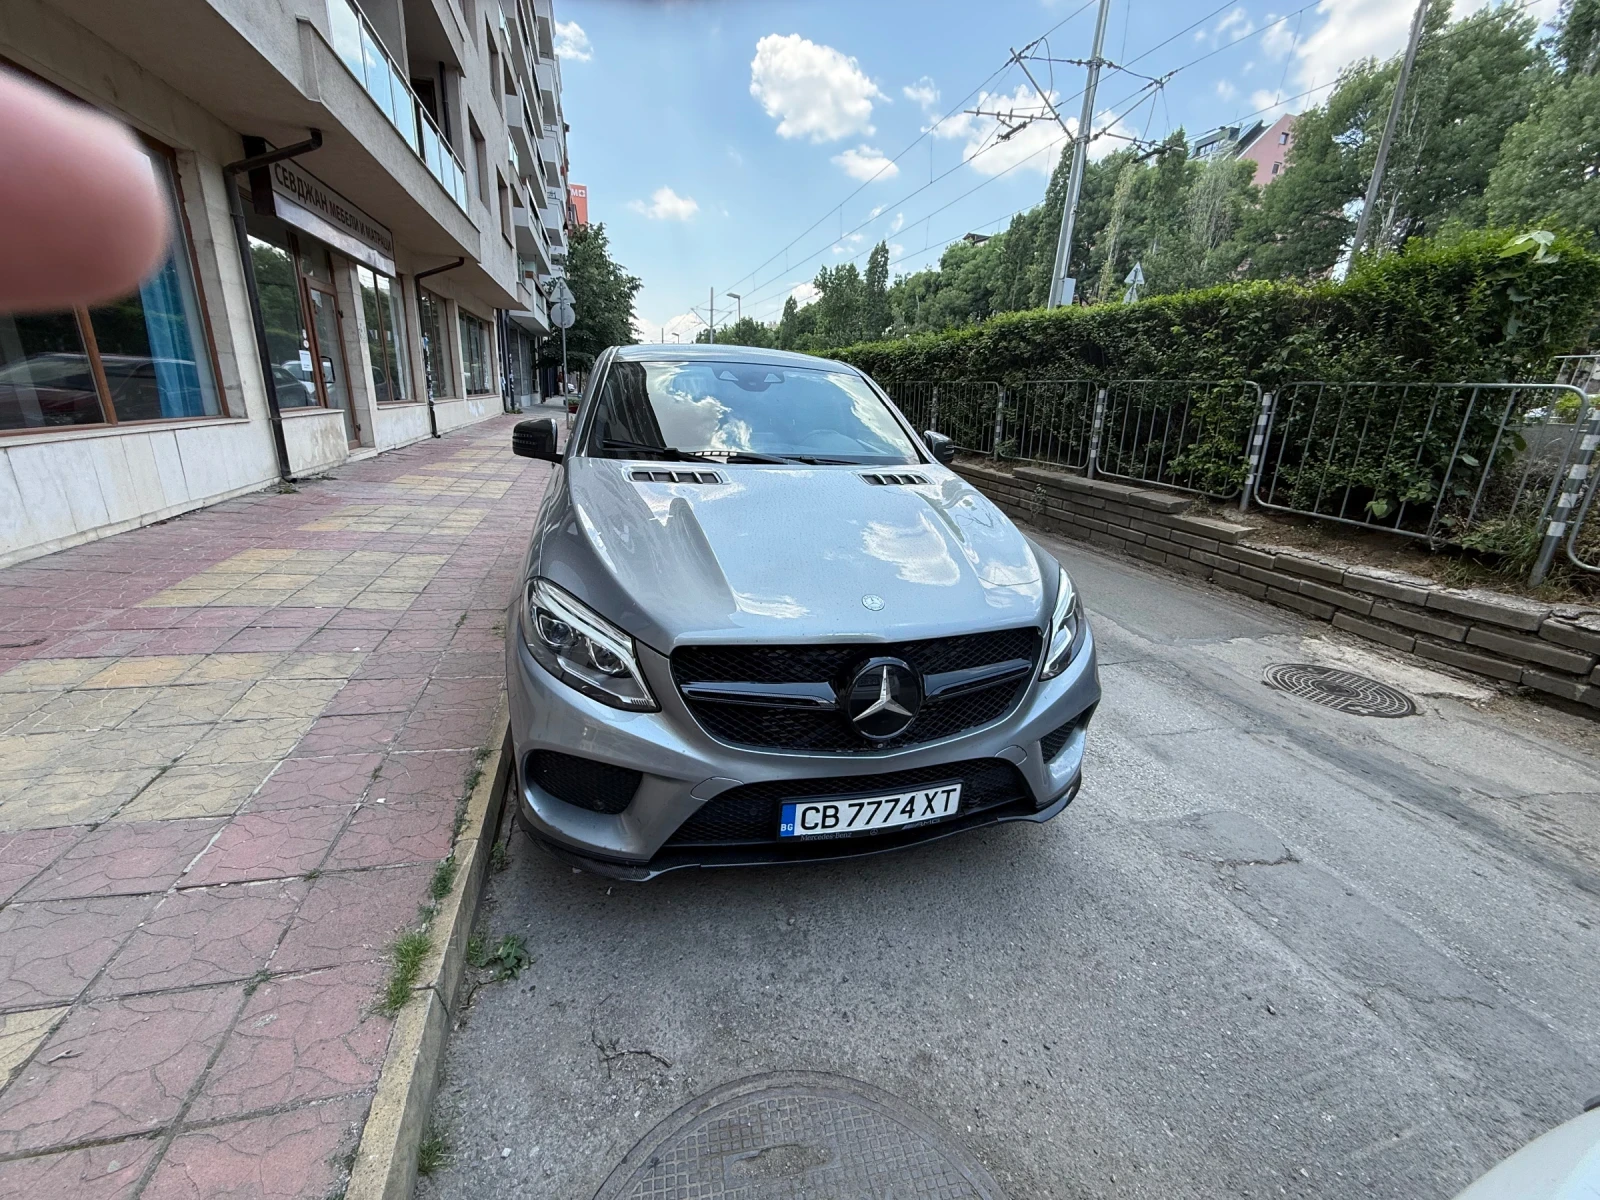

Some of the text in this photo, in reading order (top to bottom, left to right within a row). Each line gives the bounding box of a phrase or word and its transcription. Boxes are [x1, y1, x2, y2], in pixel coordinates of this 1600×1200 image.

[274, 163, 328, 213] СЕВДЖАН
[329, 201, 359, 232] МЕБЕЛИ
[780, 823, 793, 831] BG
[800, 831, 852, 842] Mercedes-Benz
